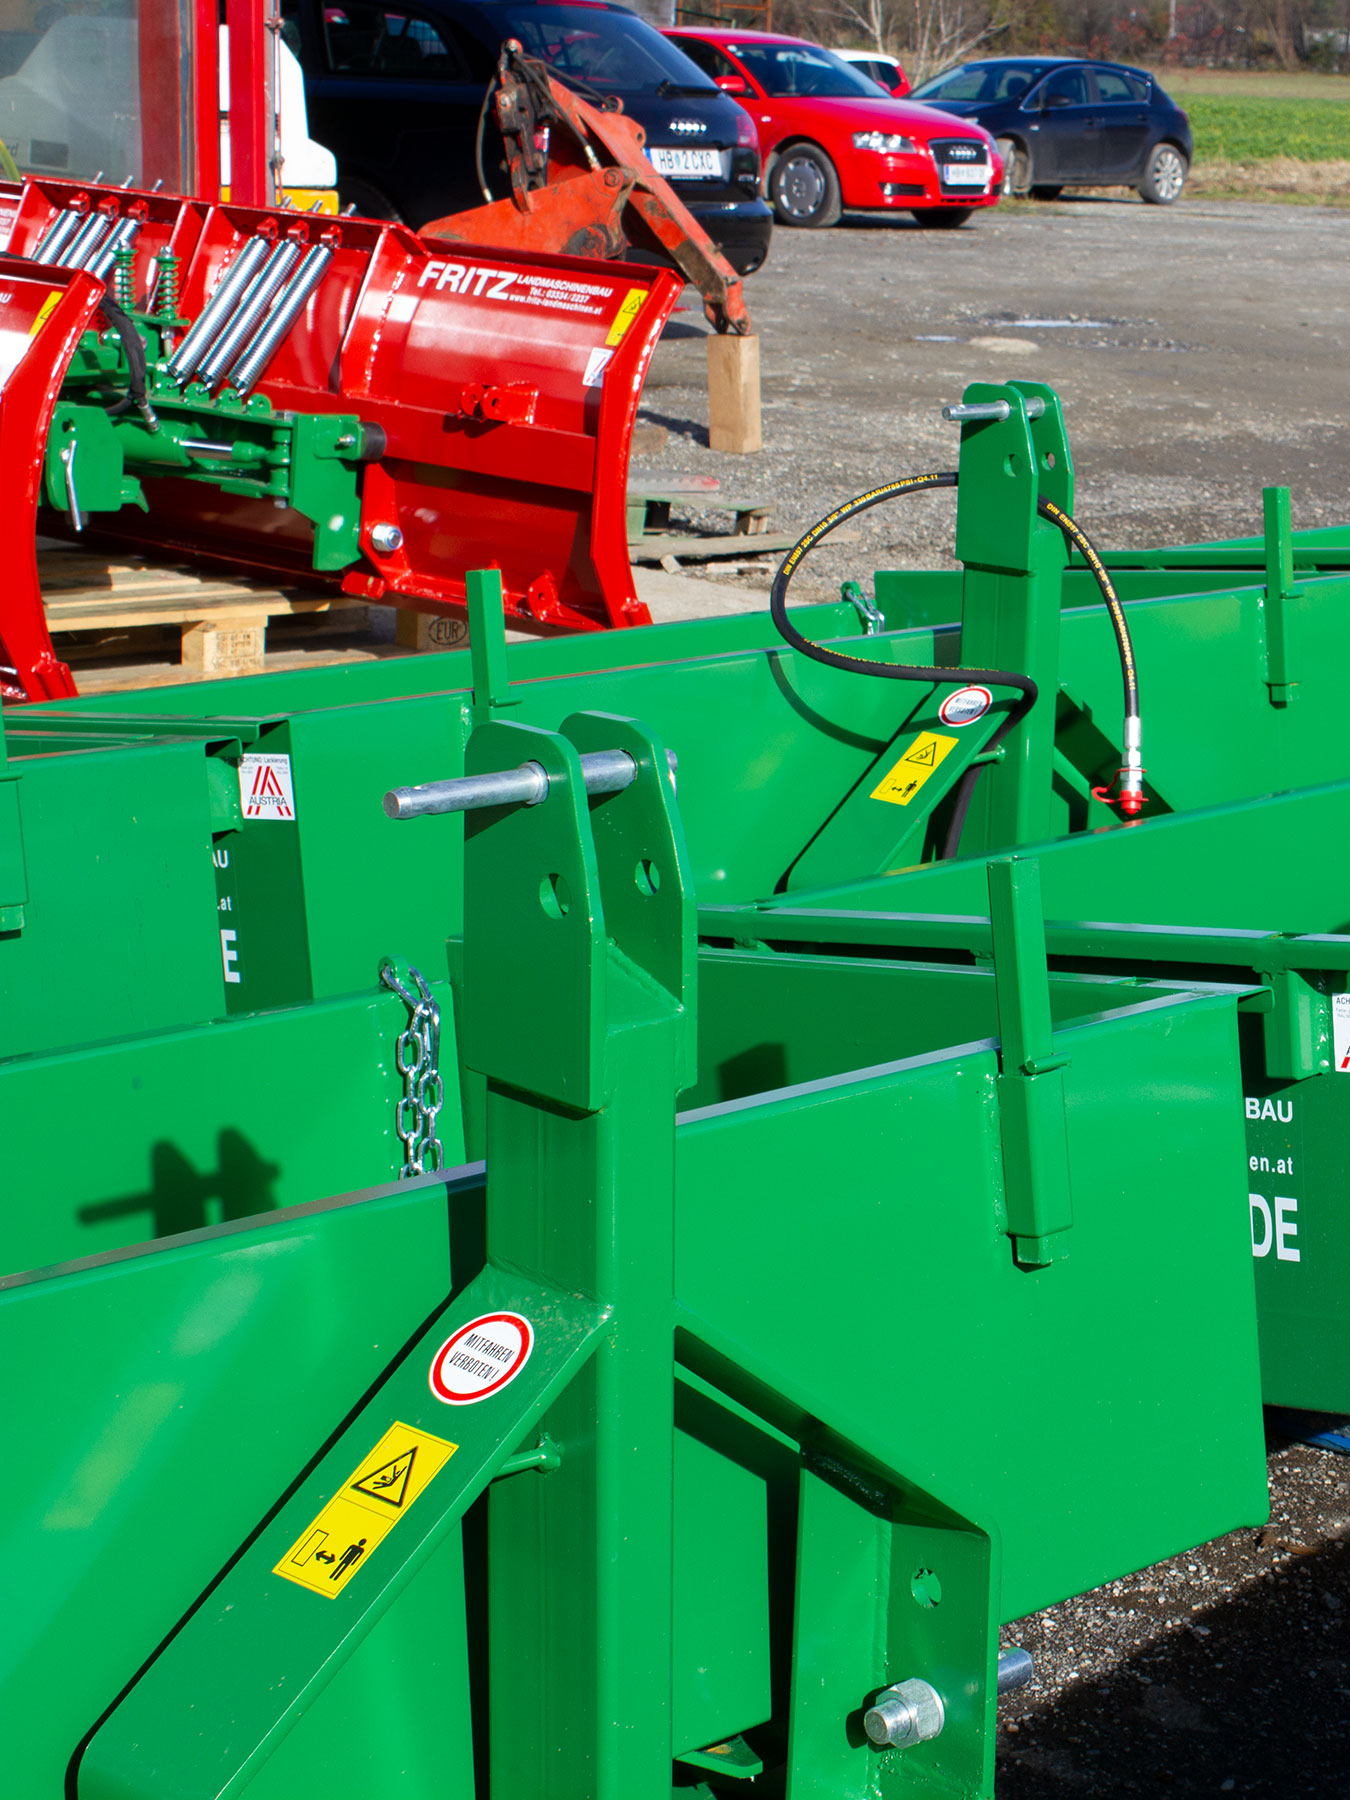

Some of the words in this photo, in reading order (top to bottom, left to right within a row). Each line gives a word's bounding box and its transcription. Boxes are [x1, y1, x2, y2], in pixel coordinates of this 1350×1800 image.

[659, 151, 674, 169] HB
[417, 260, 520, 300] FRITZ
[516, 274, 614, 298] LANDMASCHINENBAU
[1046, 503, 1060, 516] DIN
[436, 621, 460, 642] EUR
[249, 796, 288, 806] AUSTRIA
[217, 896, 233, 911] .at
[220, 929, 242, 984] E
[1245, 1097, 1293, 1123] BAU
[1249, 1155, 1293, 1175] en.at
[1249, 1193, 1301, 1262] DE
[463, 1333, 515, 1363] MITFAHREN
